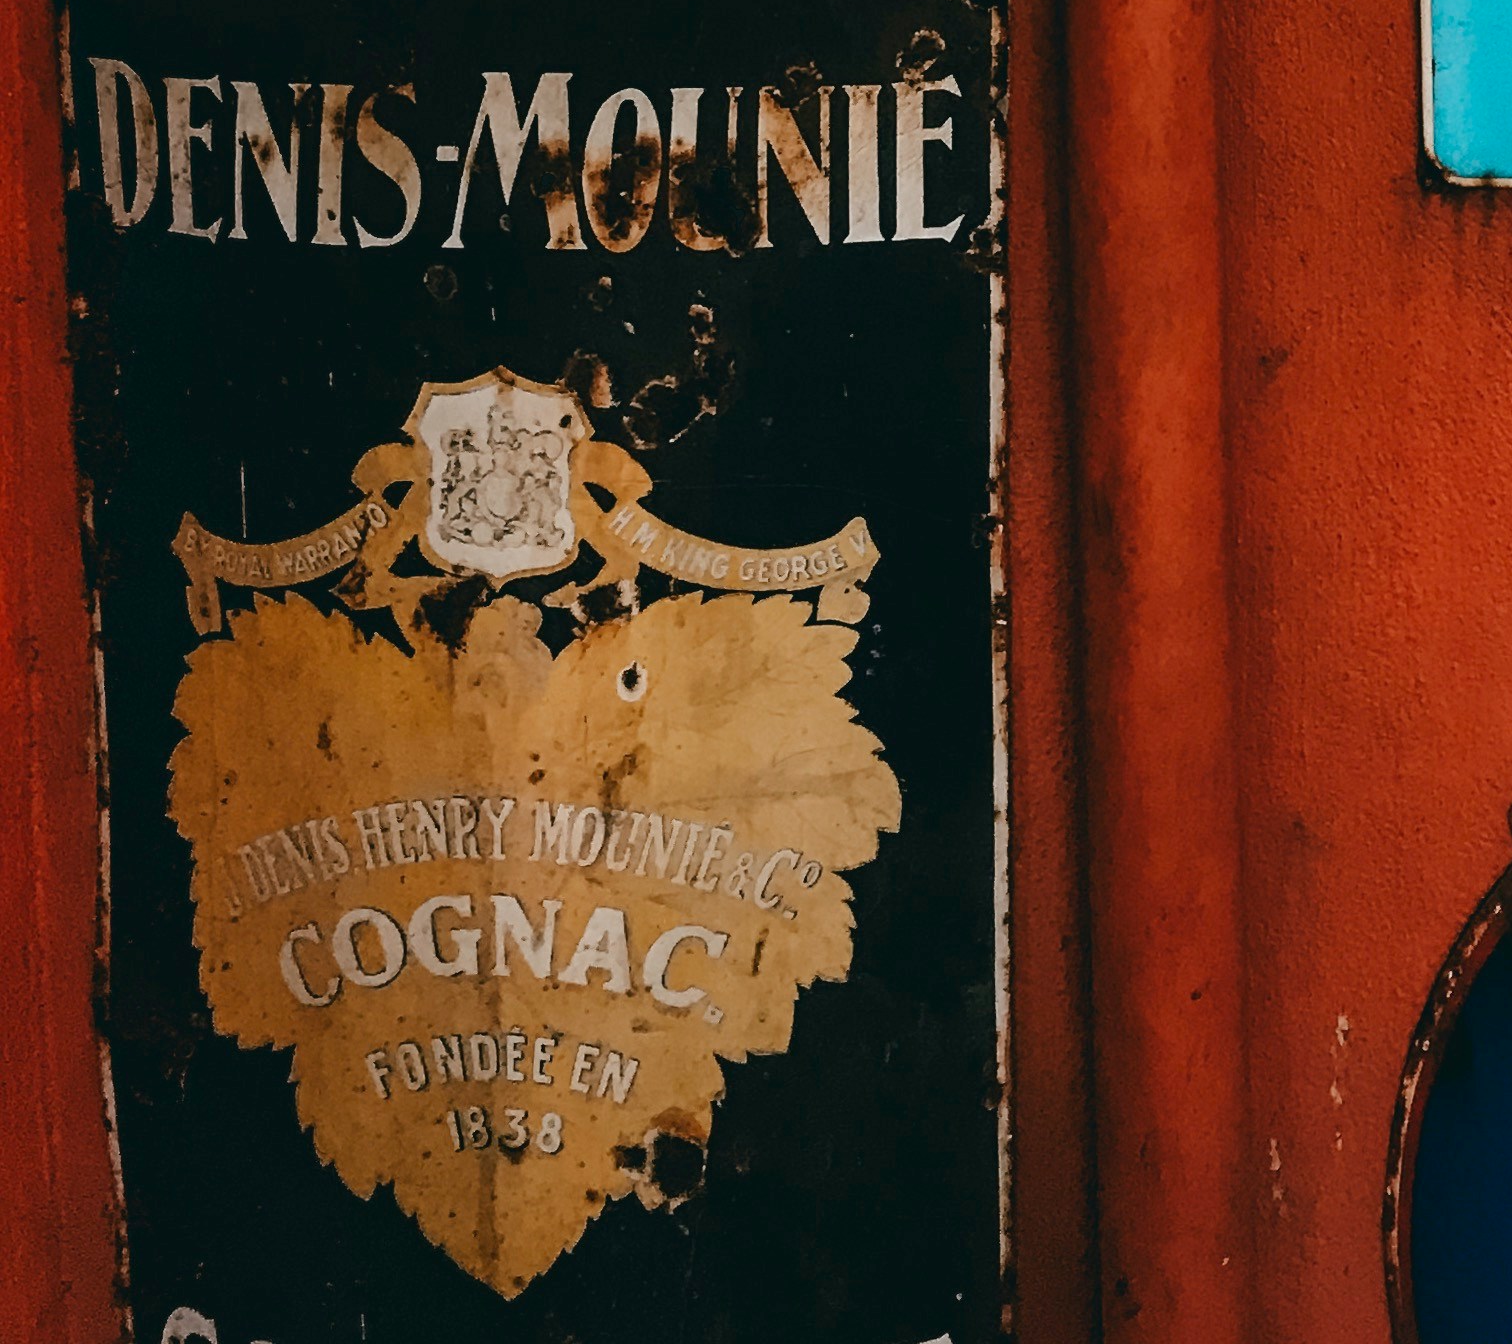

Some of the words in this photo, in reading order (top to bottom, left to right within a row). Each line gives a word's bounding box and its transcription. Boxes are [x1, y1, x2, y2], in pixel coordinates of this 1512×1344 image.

[660, 538, 732, 579] KING
[739, 543, 848, 583] GEORGE
[352, 795, 518, 870] HENRY
[569, 1042, 640, 1105] EN
[446, 1106, 565, 1155] 1838
